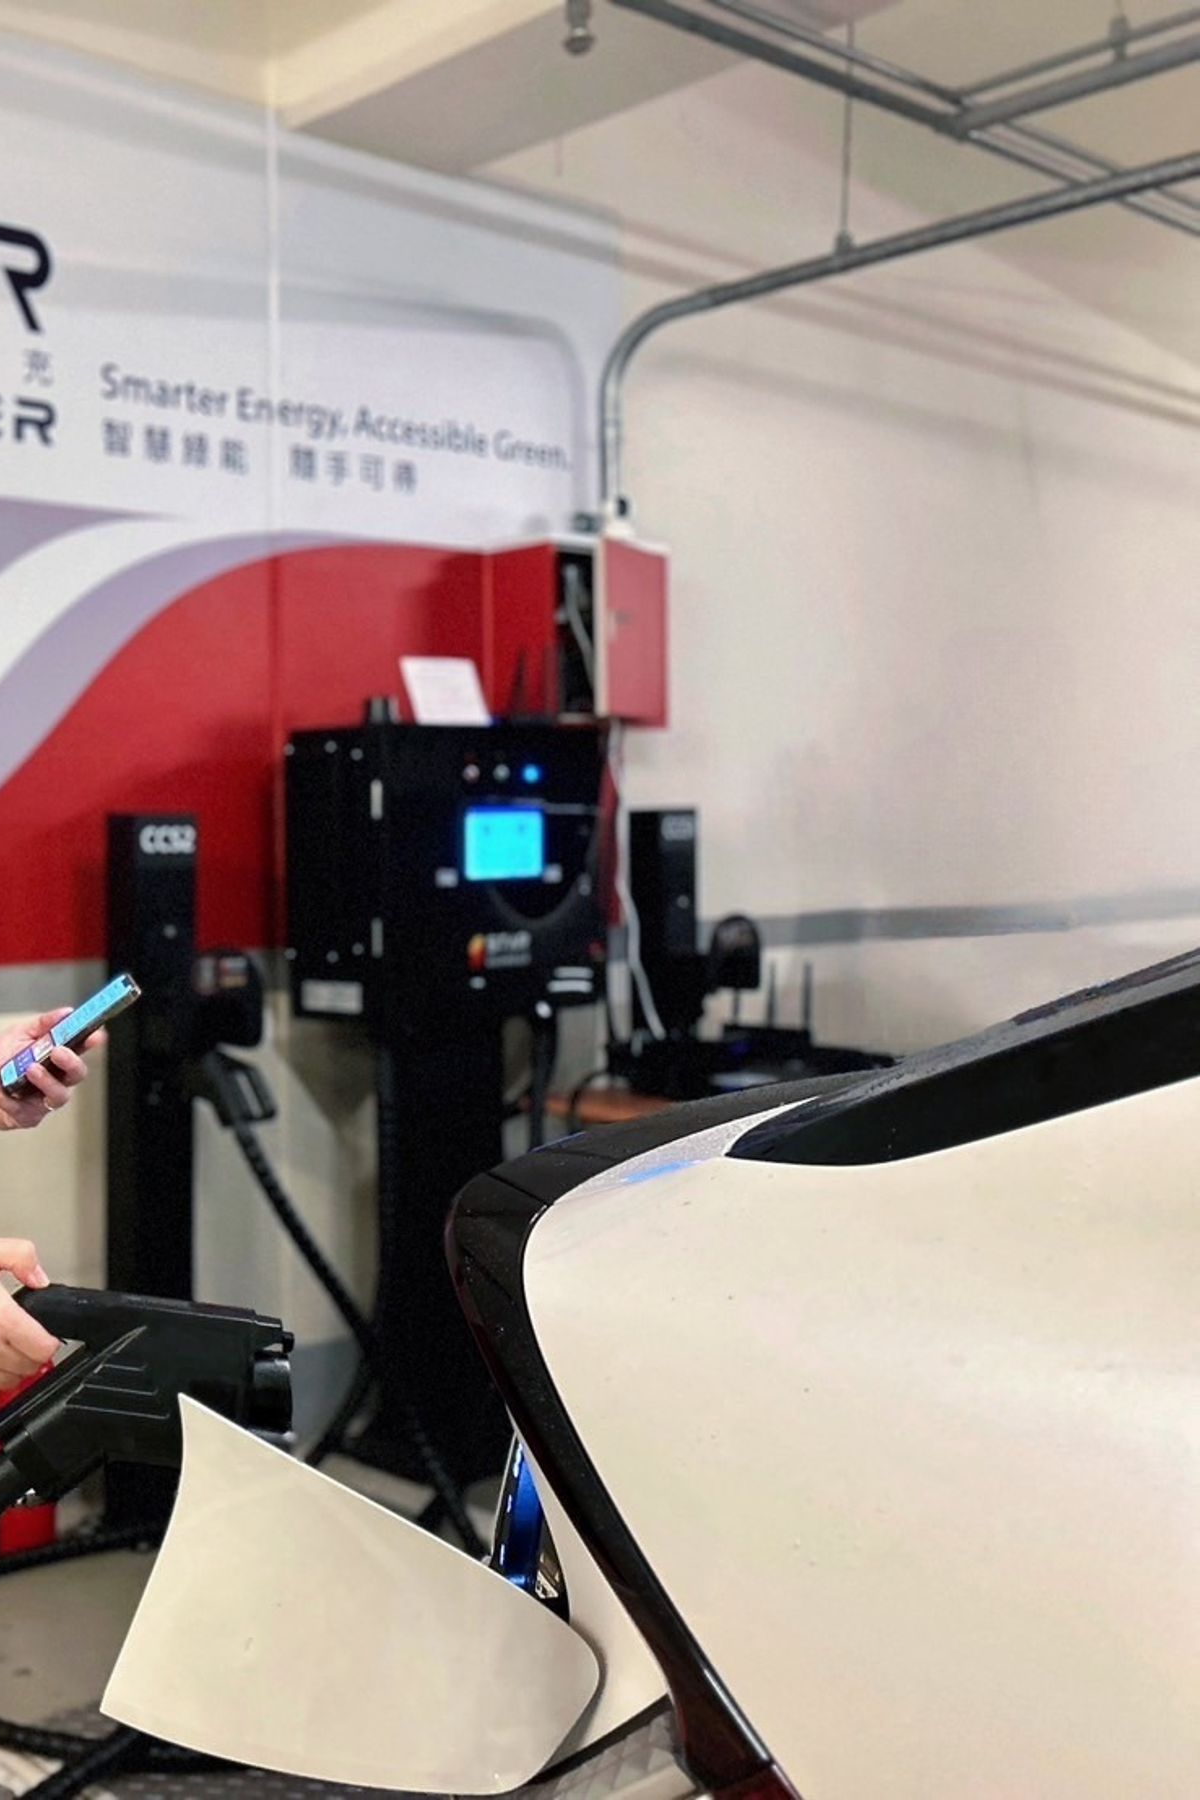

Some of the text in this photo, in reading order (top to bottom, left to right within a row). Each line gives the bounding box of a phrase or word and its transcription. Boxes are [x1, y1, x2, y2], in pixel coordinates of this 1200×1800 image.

[100, 361, 227, 417] Smarter
[353, 405, 489, 458] Accessible
[139, 824, 196, 854] CCS2
